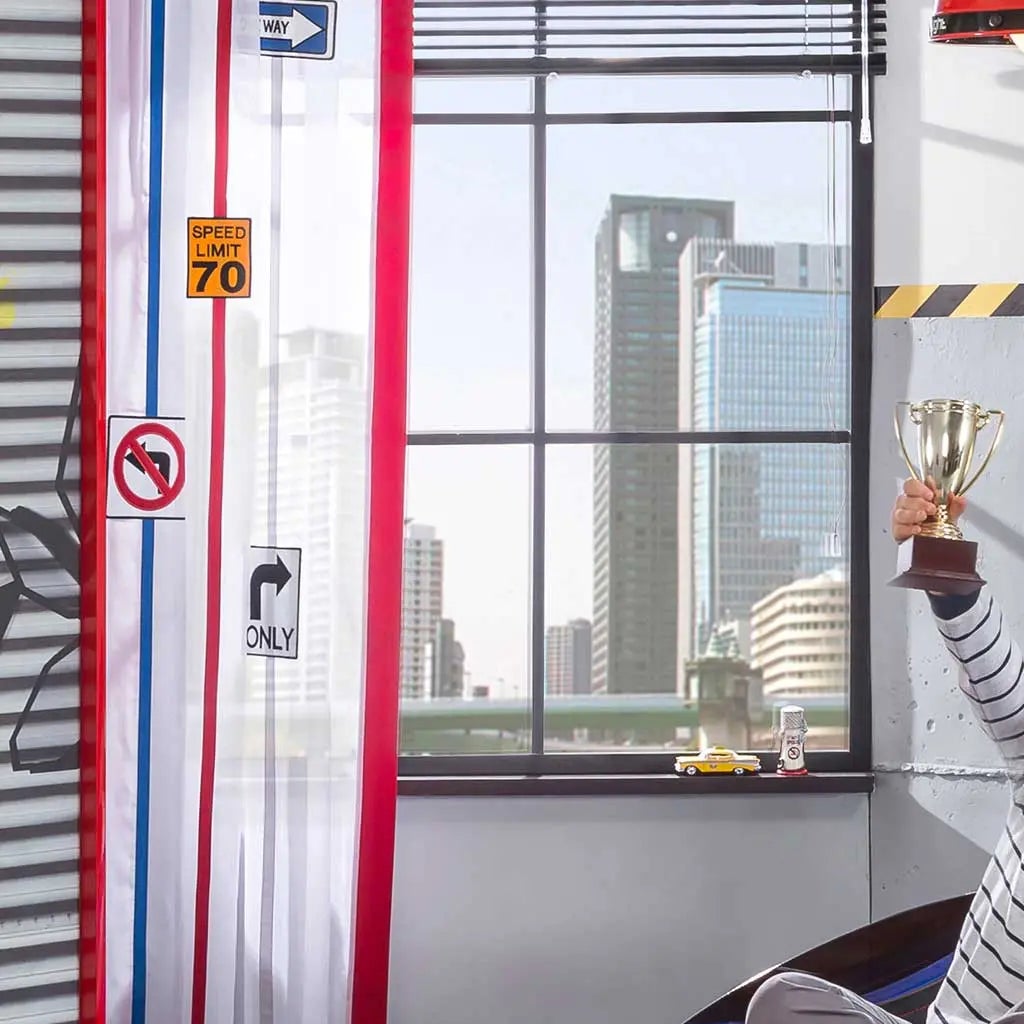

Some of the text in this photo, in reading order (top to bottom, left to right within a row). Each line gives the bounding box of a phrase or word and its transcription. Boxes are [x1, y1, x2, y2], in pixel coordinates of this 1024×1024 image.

[263, 19, 290, 35] WAY
[192, 225, 247, 240] SPEED
[196, 243, 242, 258] LIMIT
[192, 260, 246, 294] 70
[246, 625, 295, 652] ONLY
